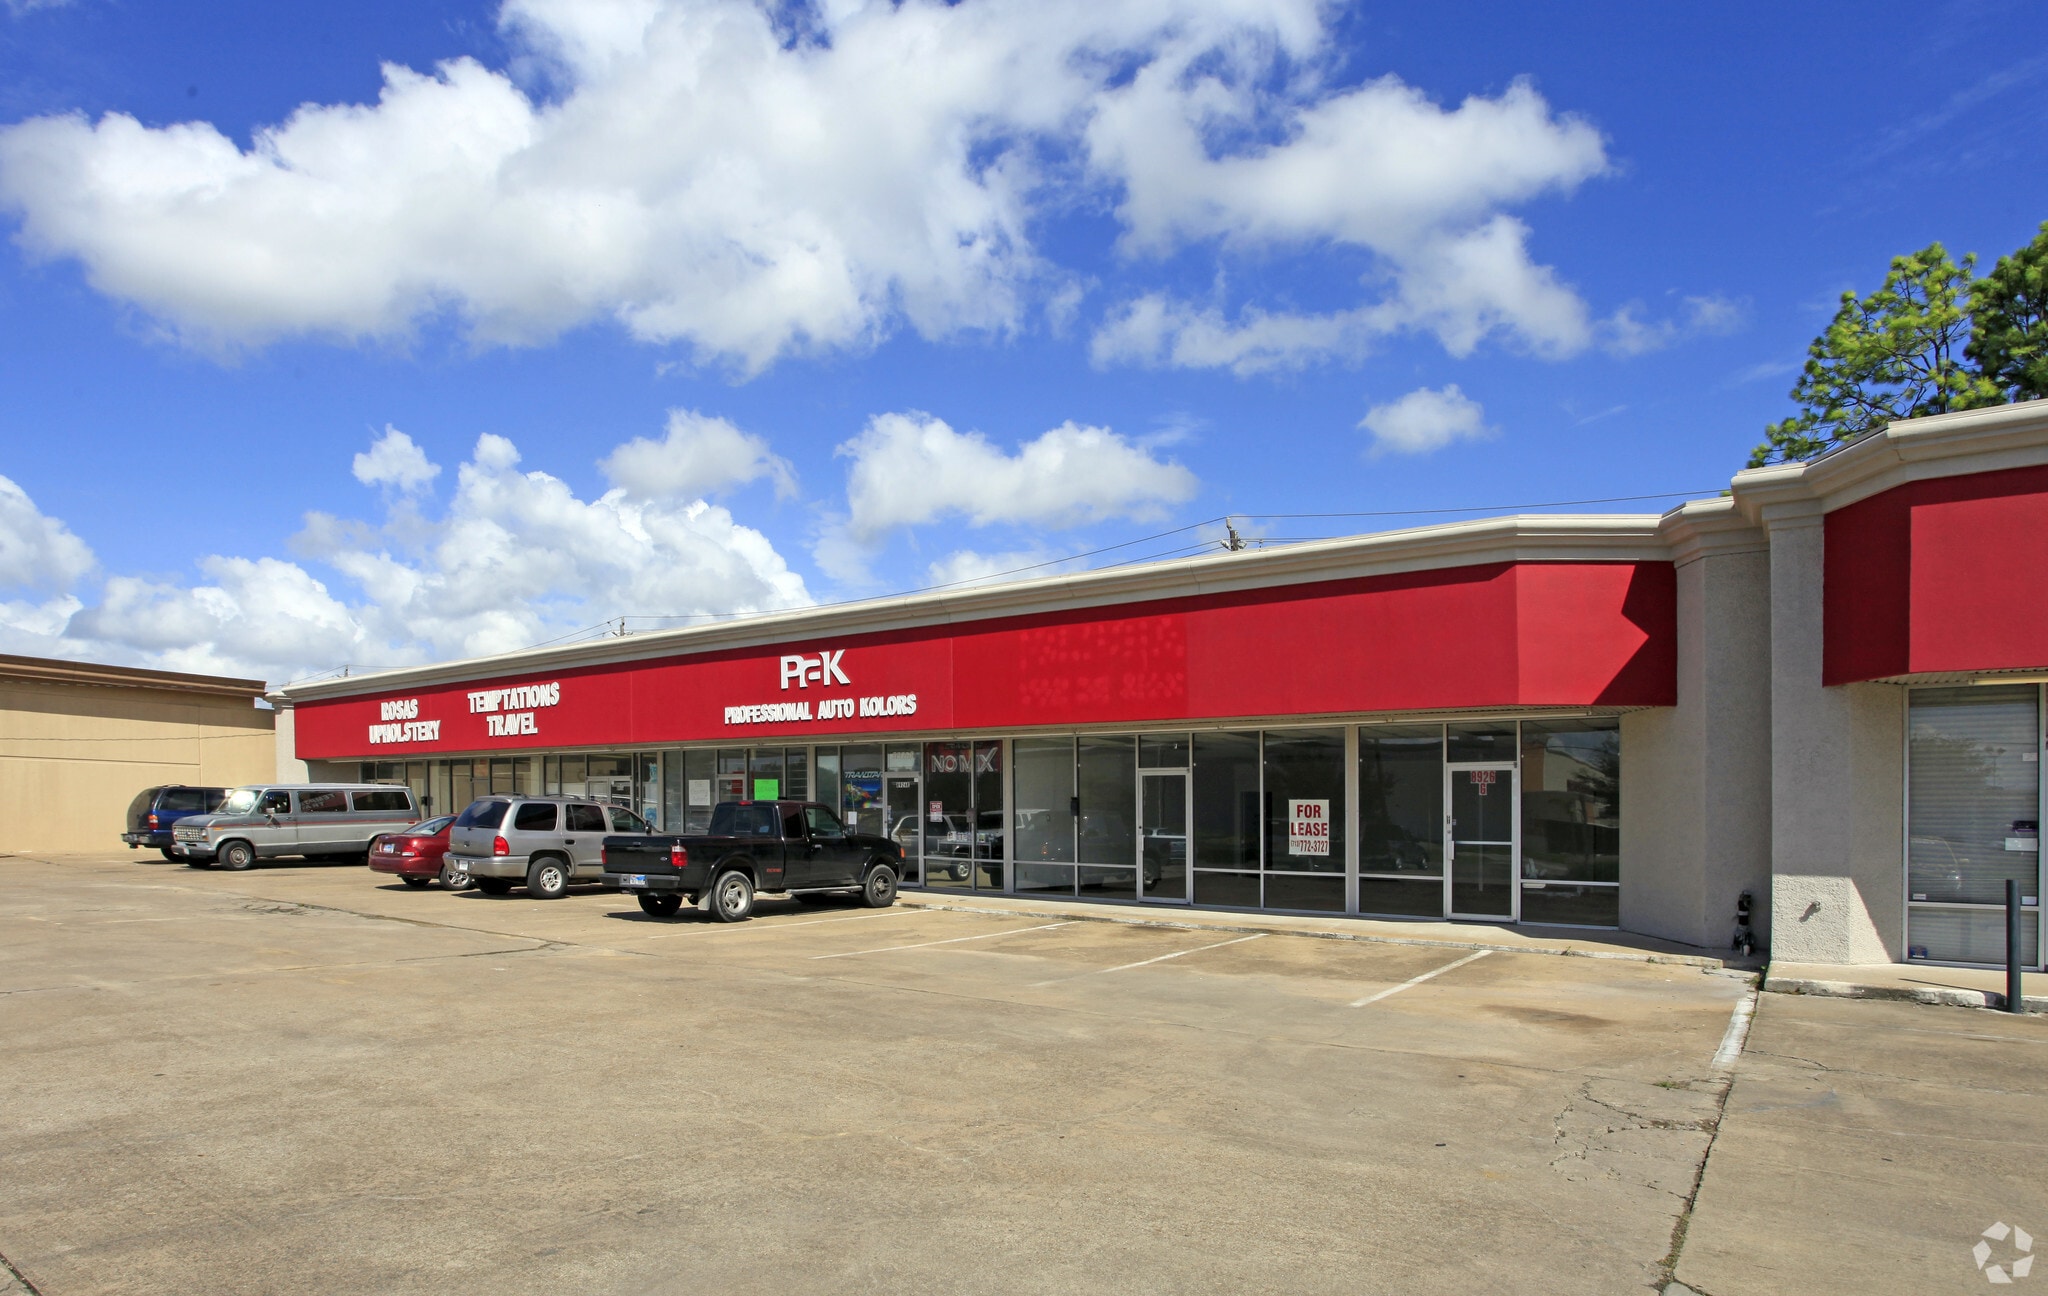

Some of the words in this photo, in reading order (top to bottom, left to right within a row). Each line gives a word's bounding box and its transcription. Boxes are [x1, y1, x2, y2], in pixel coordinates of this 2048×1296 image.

[468, 682, 559, 713] TEMPTATIONS
[381, 699, 418, 721] ROSAS
[725, 702, 812, 724] PROFESSIONAL
[818, 698, 854, 719] AUTO
[860, 694, 916, 716] KOLORS
[369, 720, 440, 743] UPHOLSTERY
[487, 712, 538, 736] TRAVEL
[1471, 771, 1495, 783] 8926
[1297, 805, 1321, 818] FOR
[1291, 822, 1327, 836] LEASE
